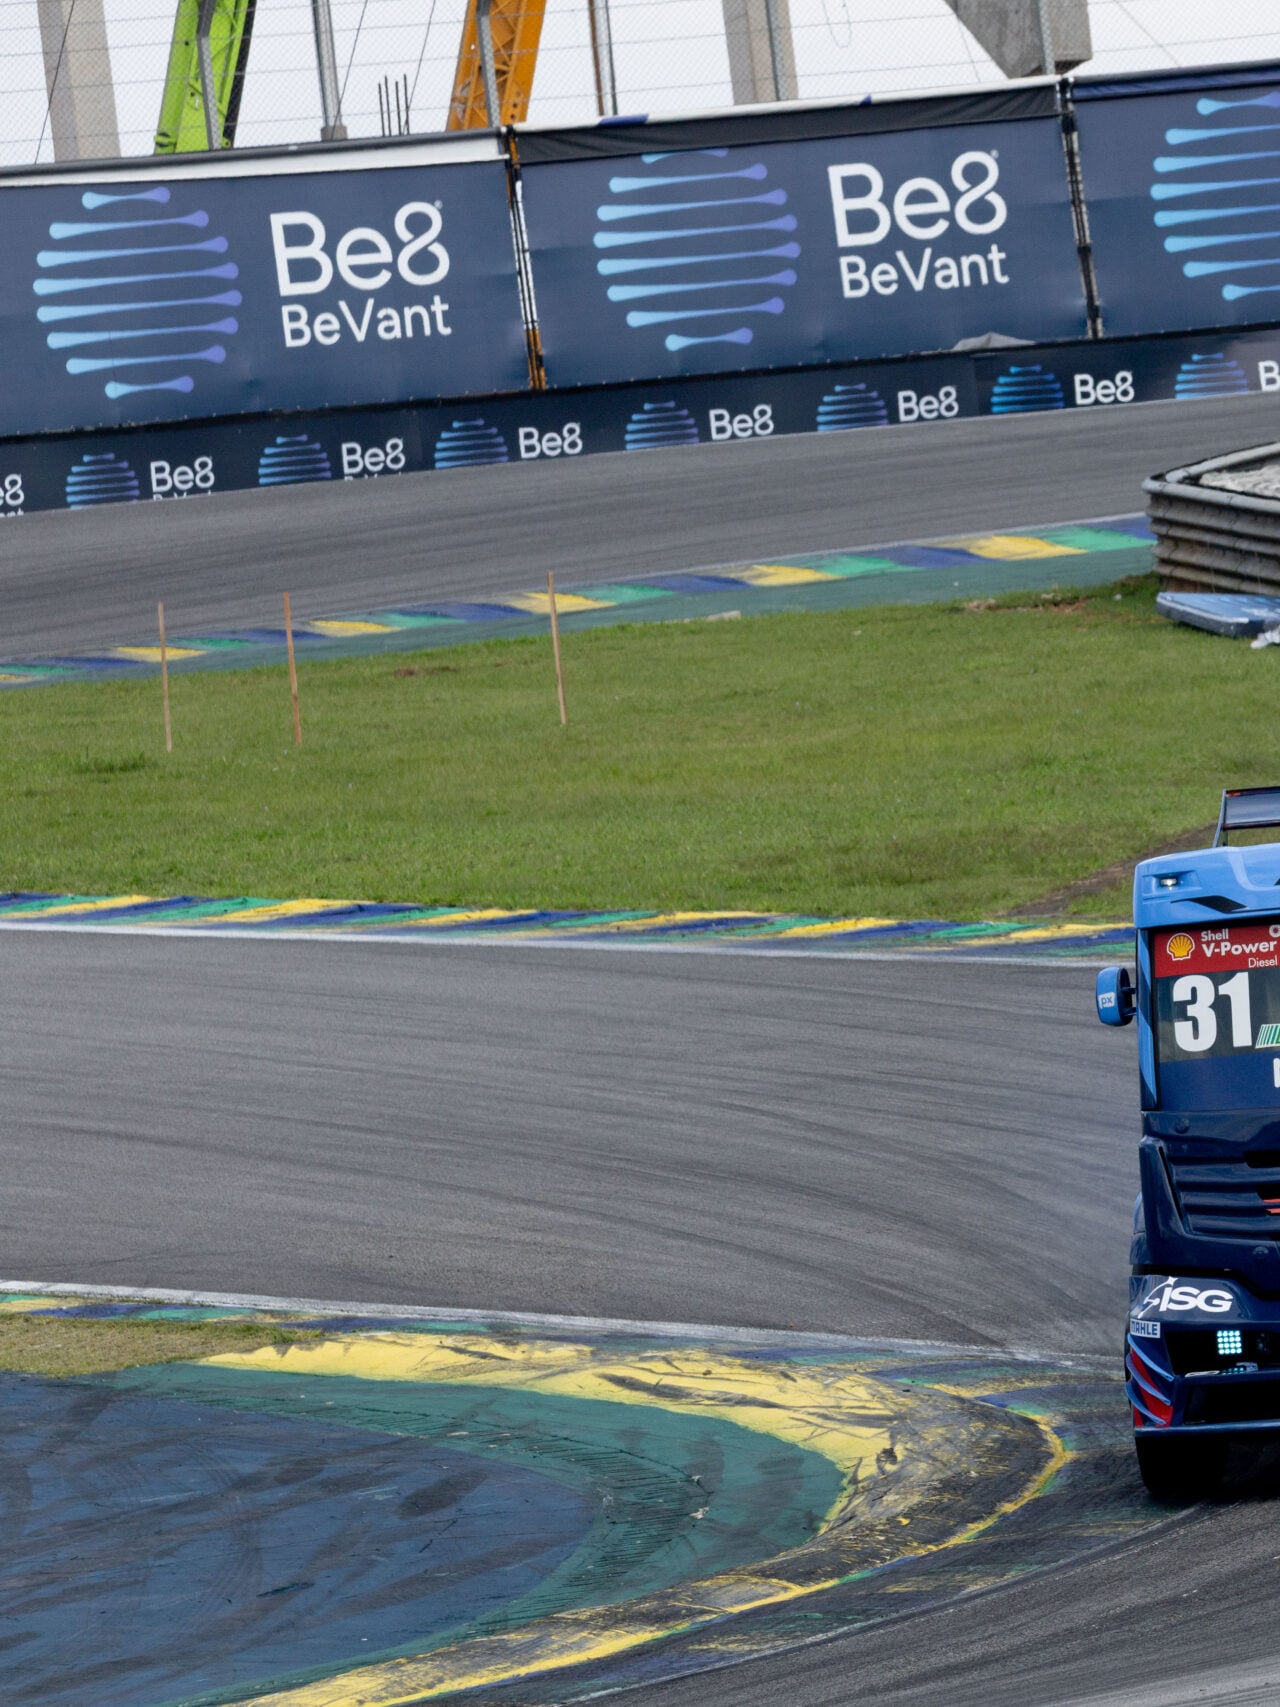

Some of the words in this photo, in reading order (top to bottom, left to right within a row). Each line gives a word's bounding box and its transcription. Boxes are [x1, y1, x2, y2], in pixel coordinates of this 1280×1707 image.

[827, 150, 1007, 248] Be8
[269, 201, 450, 297] Be8
[839, 244, 1010, 298] BeVant
[281, 294, 452, 348] BeVant
[898, 386, 959, 422] Be8
[1074, 371, 1135, 405] Be8
[709, 404, 774, 440] Be8
[341, 438, 406, 474] Be8
[518, 423, 583, 459] Be8
[150, 456, 215, 492] Be8
[1201, 928, 1229, 941] Shell
[1201, 940, 1277, 957] V-Power
[1248, 954, 1278, 968] Diesel
[1172, 971, 1253, 1052] 31
[1131, 1321, 1158, 1336] MAHLE
